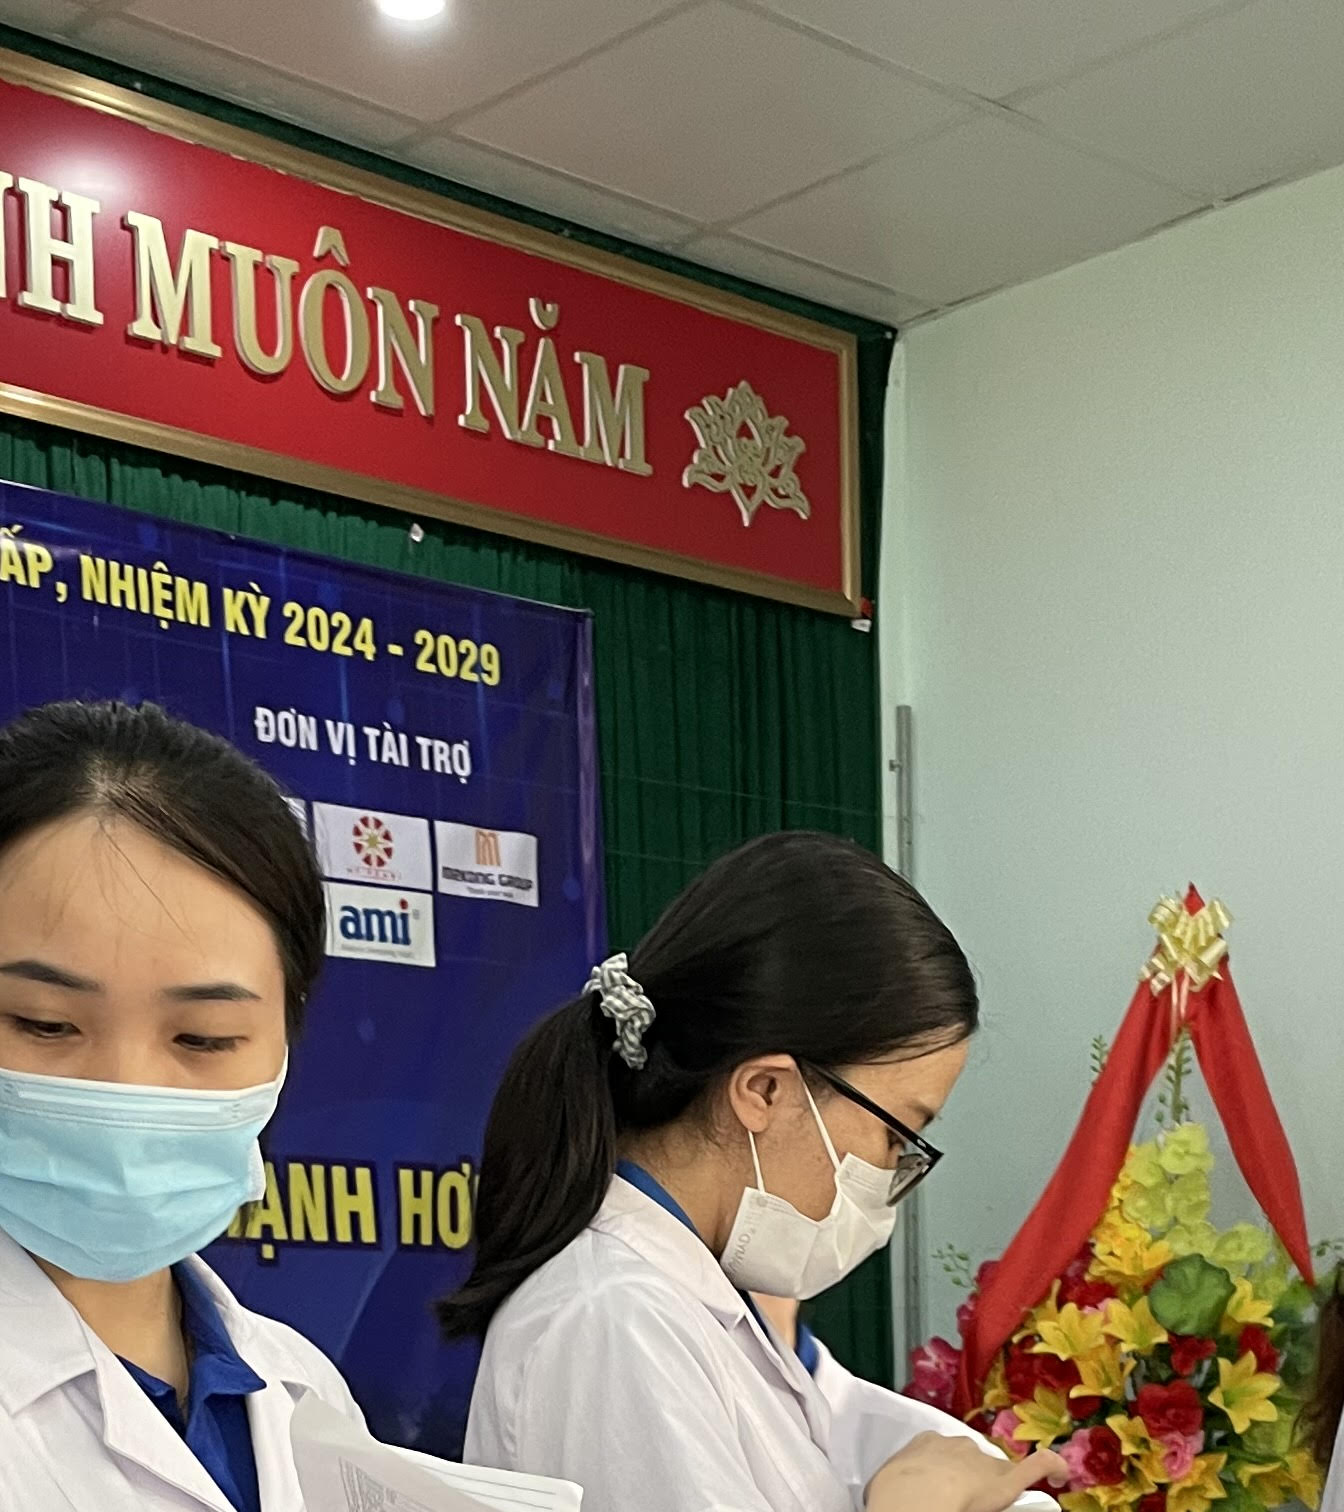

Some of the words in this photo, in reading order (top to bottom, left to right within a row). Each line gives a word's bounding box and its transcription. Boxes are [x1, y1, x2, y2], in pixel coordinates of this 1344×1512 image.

[126, 227, 440, 419] MUÔN
[457, 297, 653, 477] NĂM
[81, 561, 212, 632] NHIỆM
[222, 571, 274, 639] KỲ
[283, 601, 377, 665] 2024
[416, 627, 502, 687] 2029
[254, 706, 318, 751] ĐƠN
[325, 719, 356, 765] VỊ
[363, 722, 409, 767] TÀI
[415, 735, 472, 784] TRỢ
[340, 899, 412, 946] ami
[228, 1161, 377, 1260] ẠNH
[399, 1162, 480, 1249] HƠ
